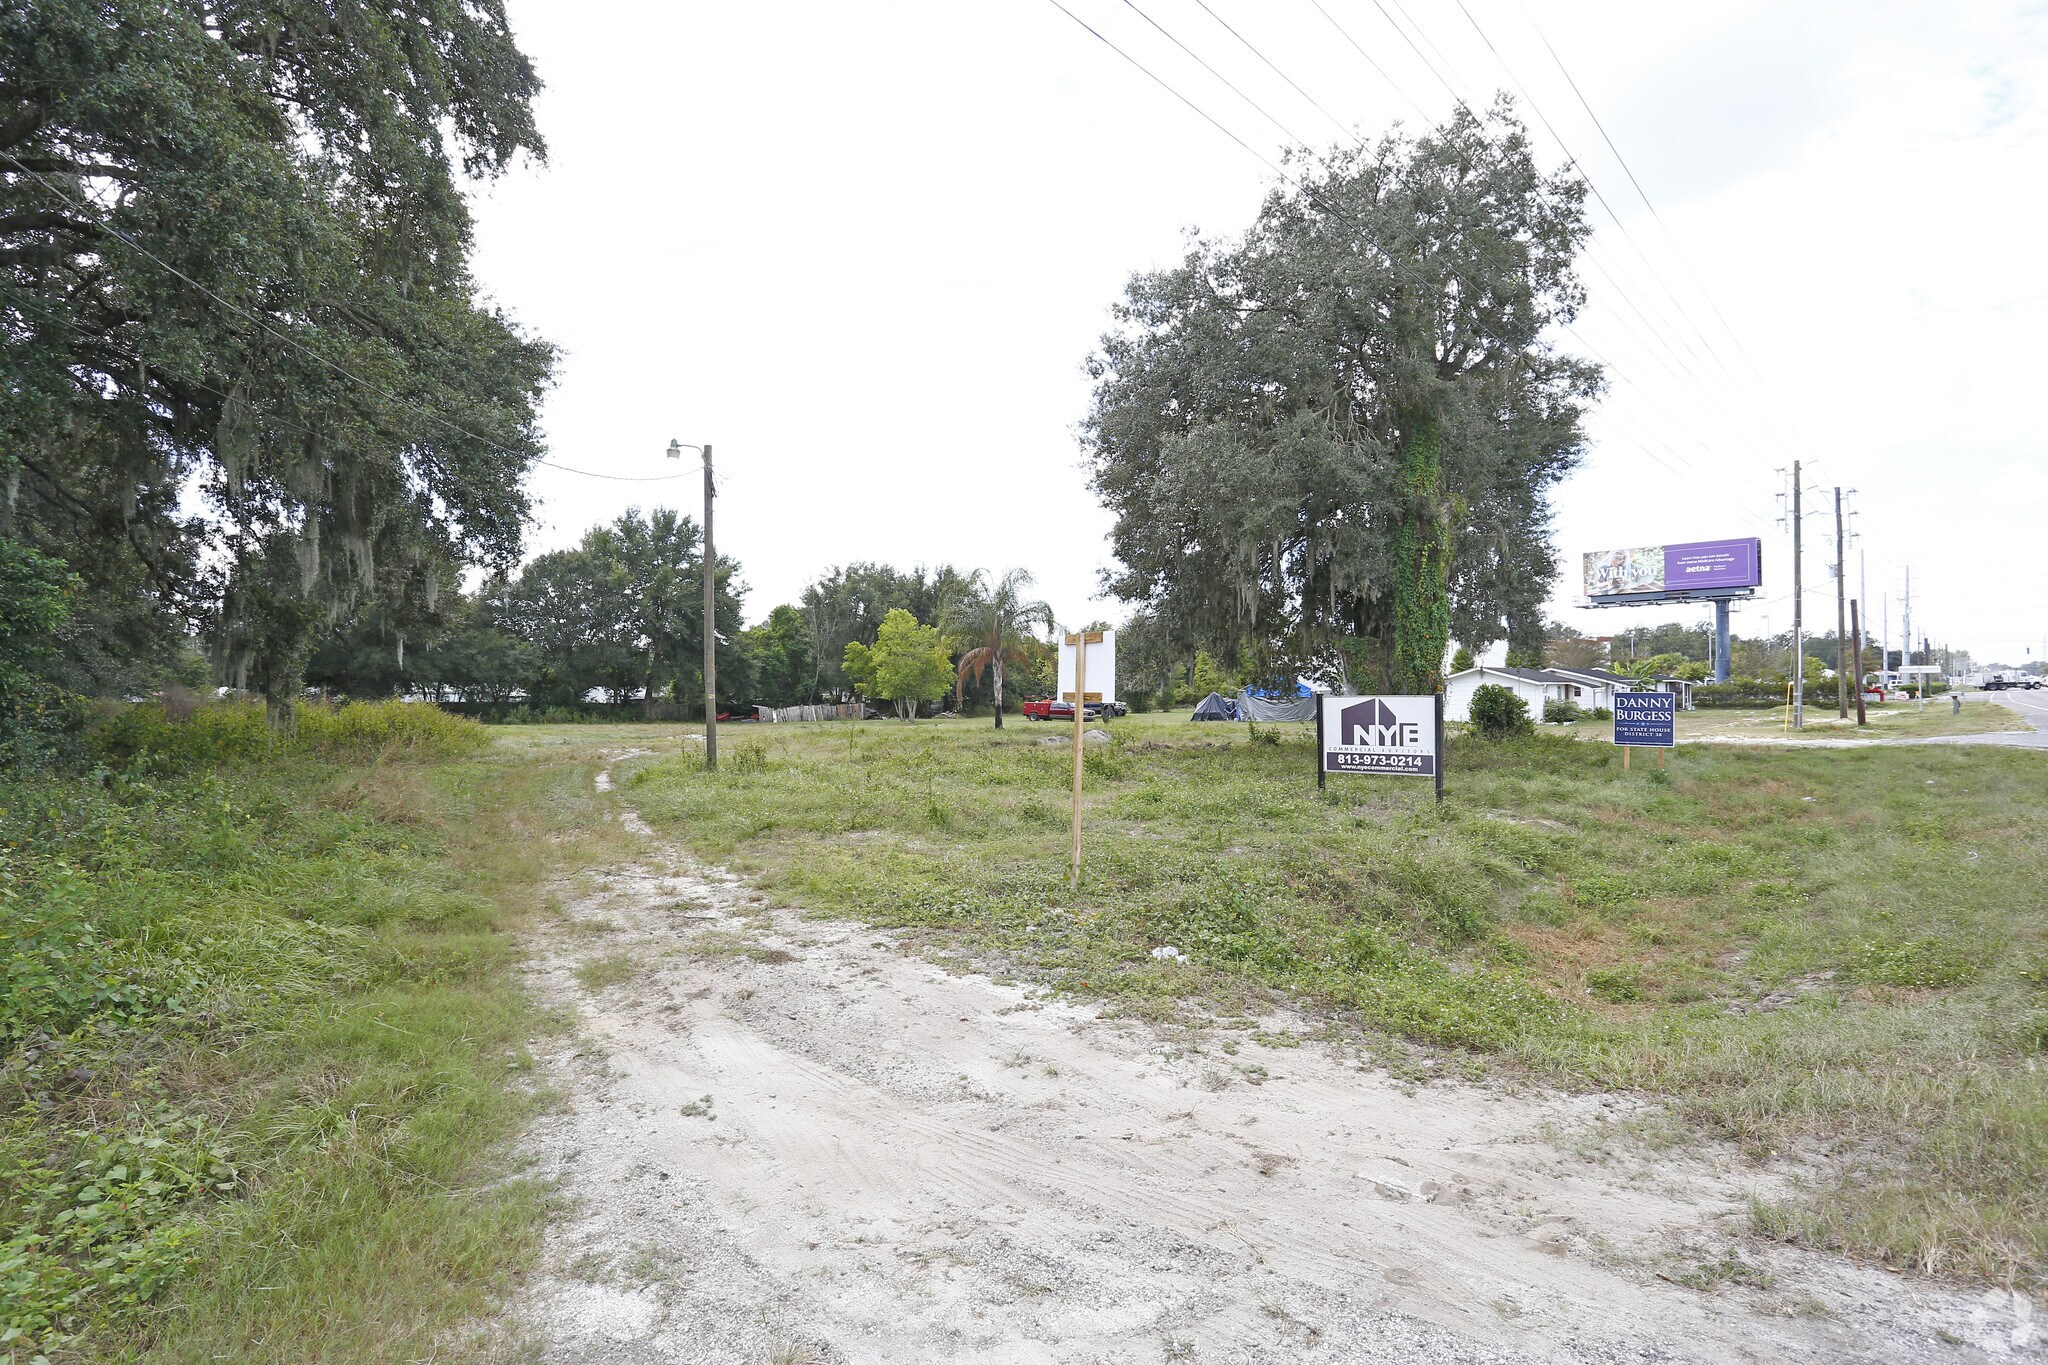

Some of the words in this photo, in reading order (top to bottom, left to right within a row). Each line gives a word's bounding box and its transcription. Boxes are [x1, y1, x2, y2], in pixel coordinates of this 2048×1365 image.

[1596, 566, 1628, 579] With
[1631, 567, 1658, 580] you
[1616, 697, 1672, 708] DANNY
[1616, 708, 1672, 721] BURGESS
[1353, 723, 1418, 747] NYE
[1338, 754, 1422, 766] 813-973-0214
